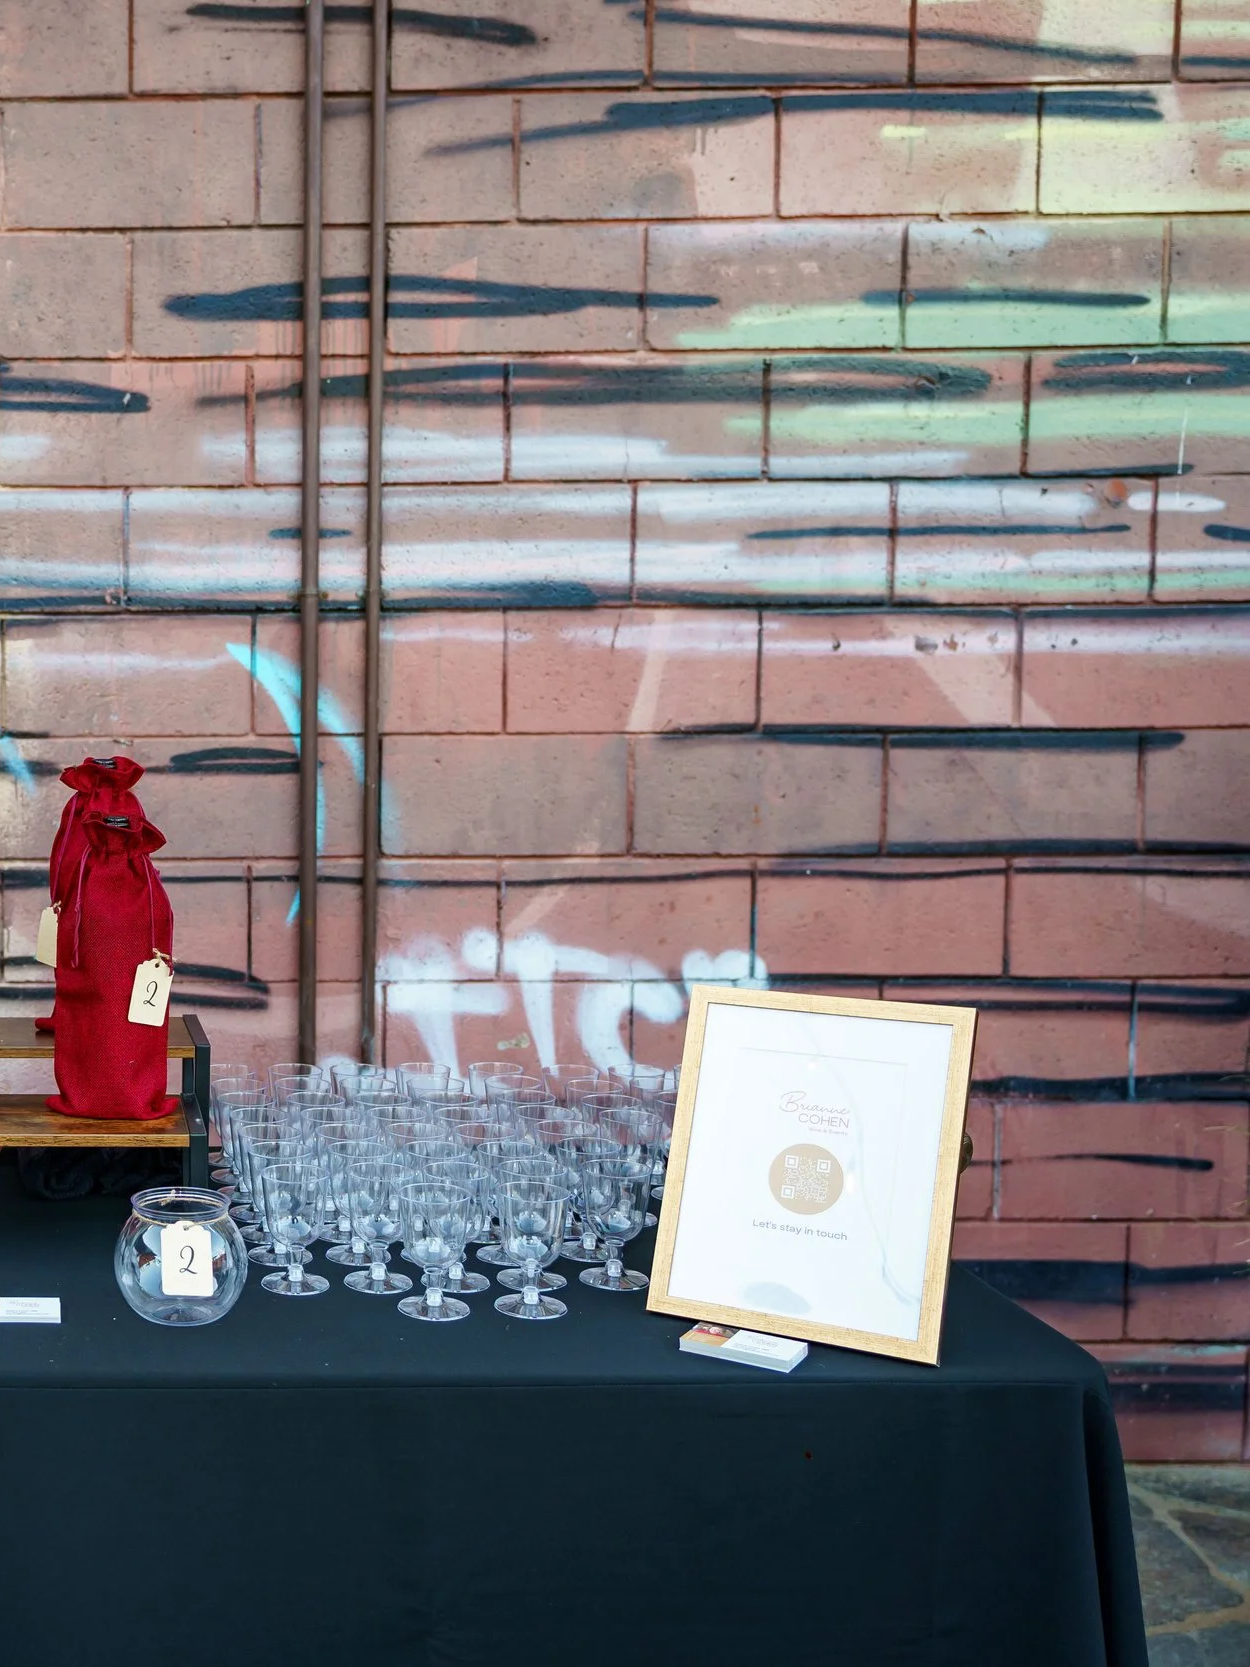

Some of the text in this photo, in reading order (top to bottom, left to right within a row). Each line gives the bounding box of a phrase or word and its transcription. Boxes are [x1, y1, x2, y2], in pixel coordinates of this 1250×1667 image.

[143, 980, 158, 1007] 2
[779, 1091, 851, 1115] Brianne
[798, 1113, 850, 1128] COHEN
[752, 1218, 848, 1240] Let's stay in touch
[179, 1245, 197, 1275] 2
